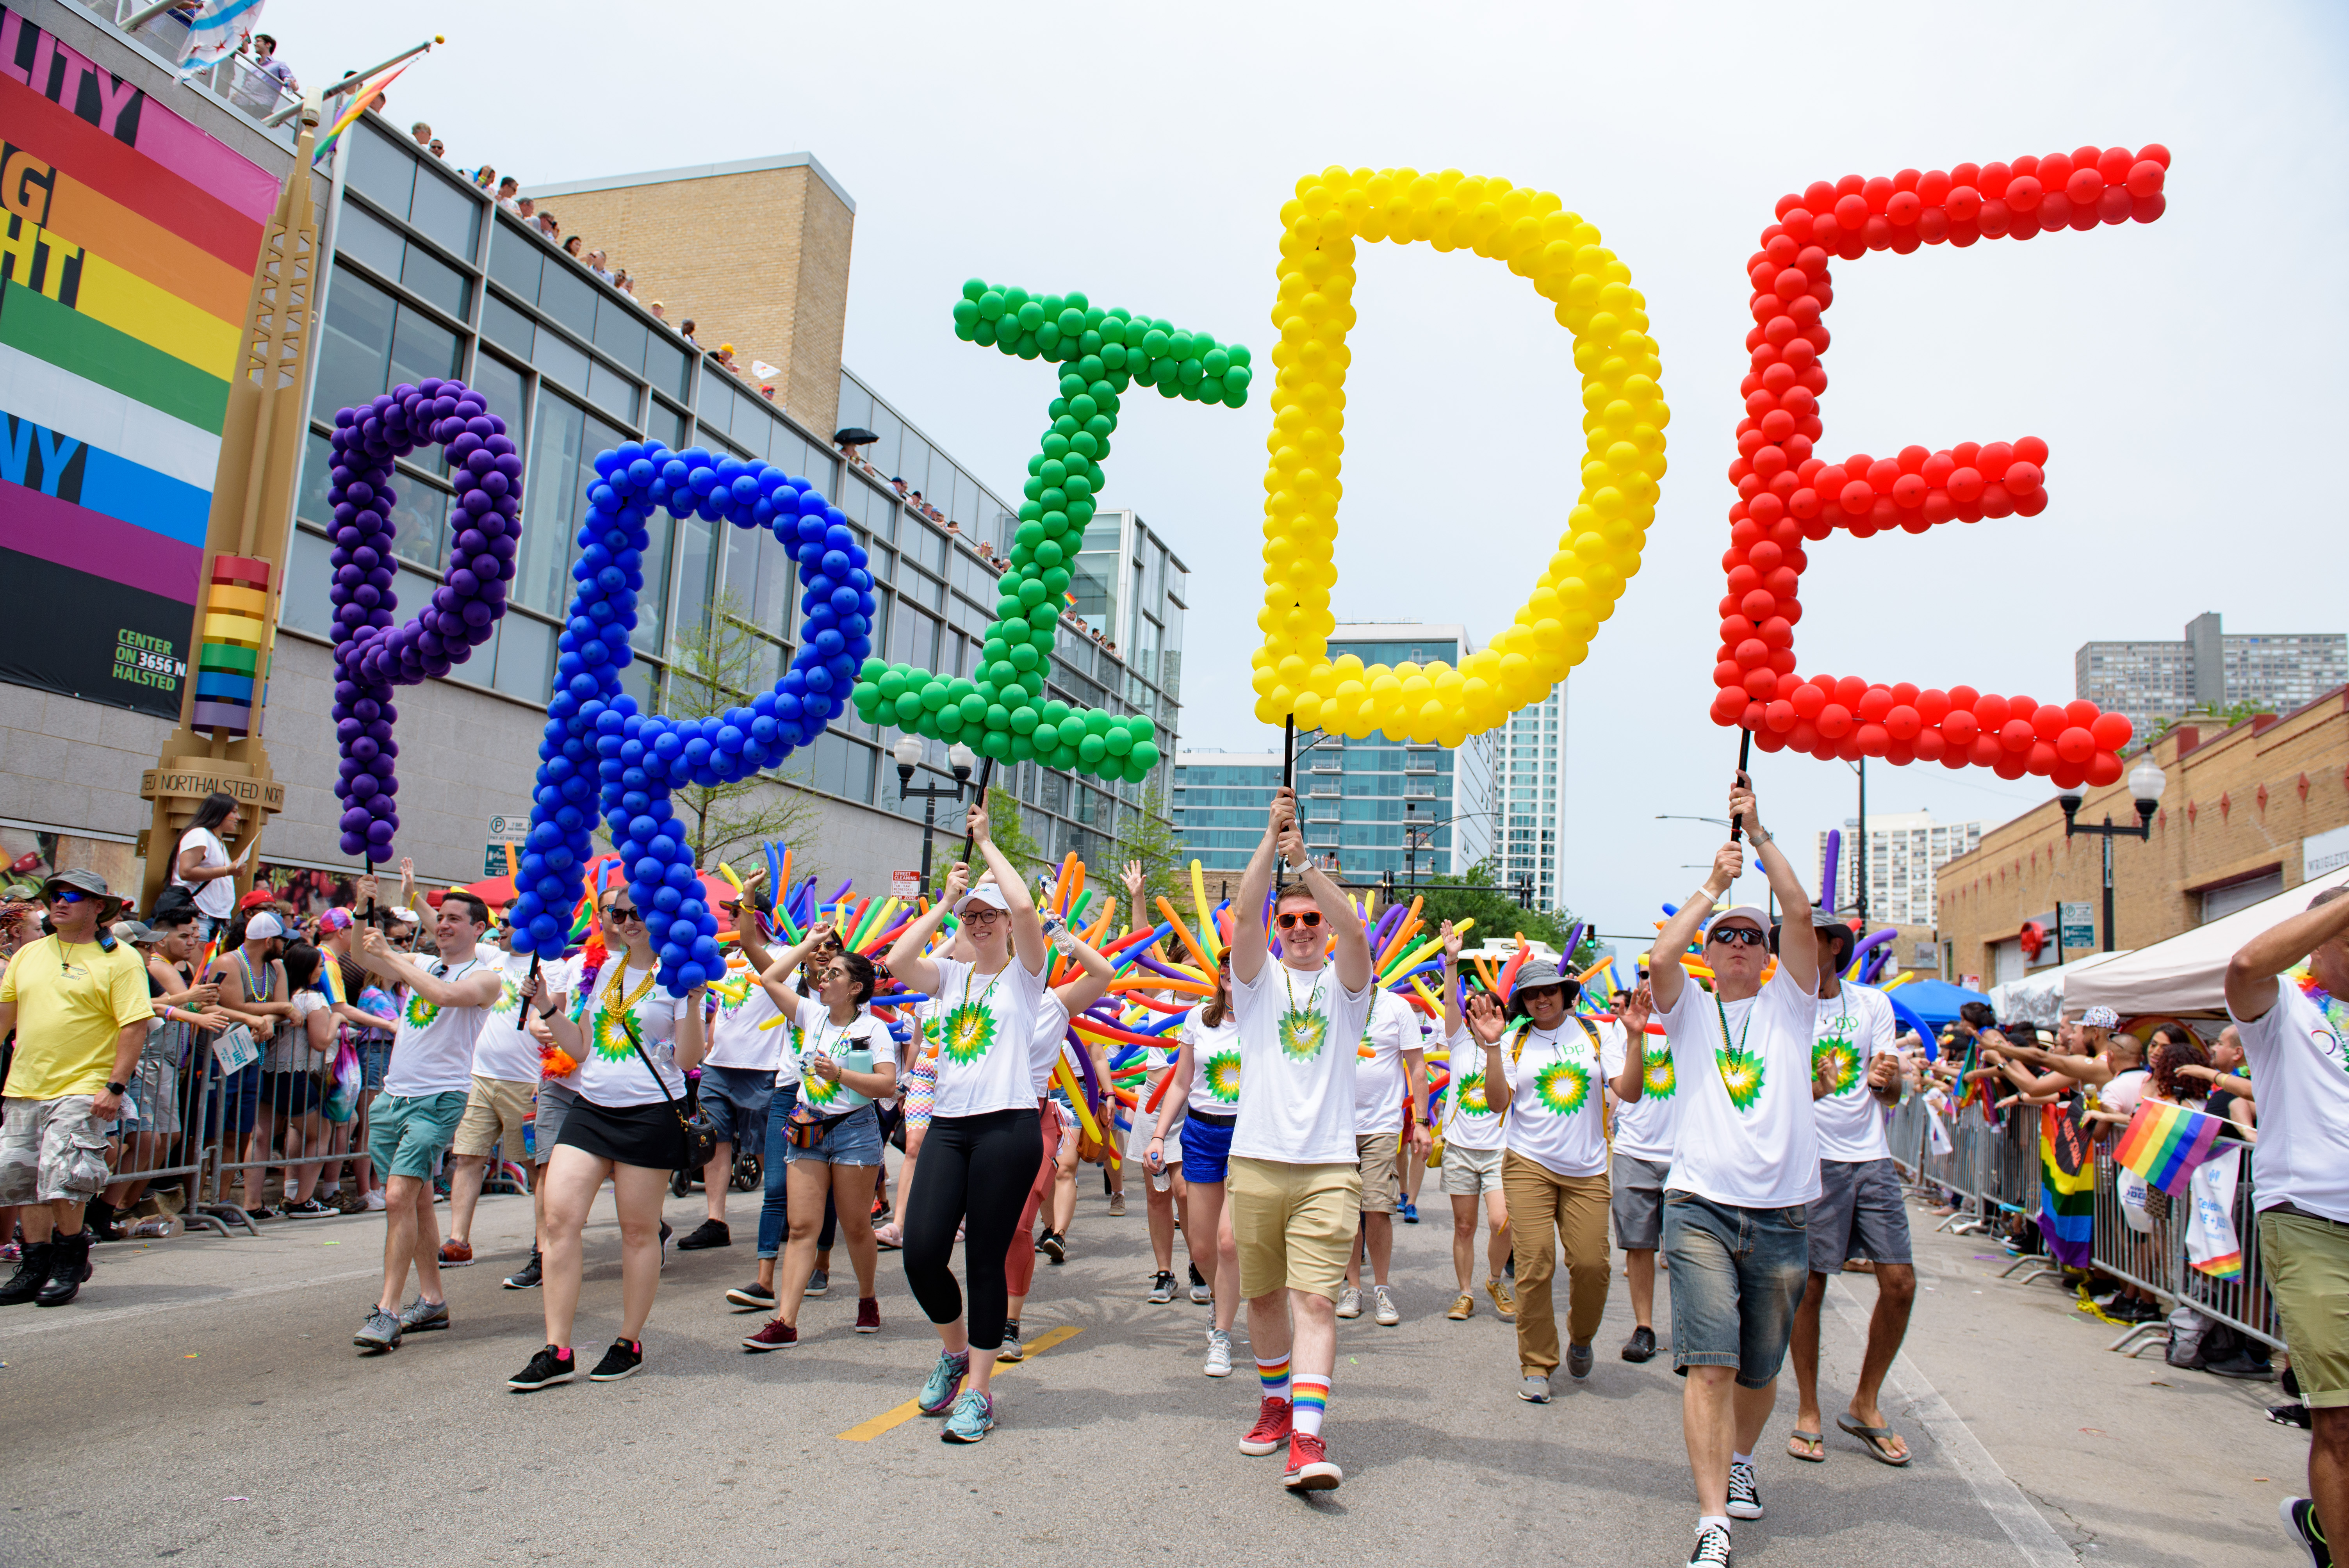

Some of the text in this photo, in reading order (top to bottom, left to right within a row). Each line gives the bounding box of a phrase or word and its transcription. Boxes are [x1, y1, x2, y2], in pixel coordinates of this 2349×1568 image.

[0, 7, 137, 137] LITY
[0, 138, 50, 224] G
[118, 628, 173, 656] CENTER
[115, 646, 137, 664] ON
[138, 652, 173, 673] 3656
[112, 663, 176, 691] HALSTED
[972, 887, 990, 896] pride
[640, 992, 656, 1002] p
[1835, 1016, 1858, 1032] bp
[232, 1050, 248, 1066] Jan
[829, 1041, 850, 1058] bp
[1562, 1044, 1584, 1055] bp
